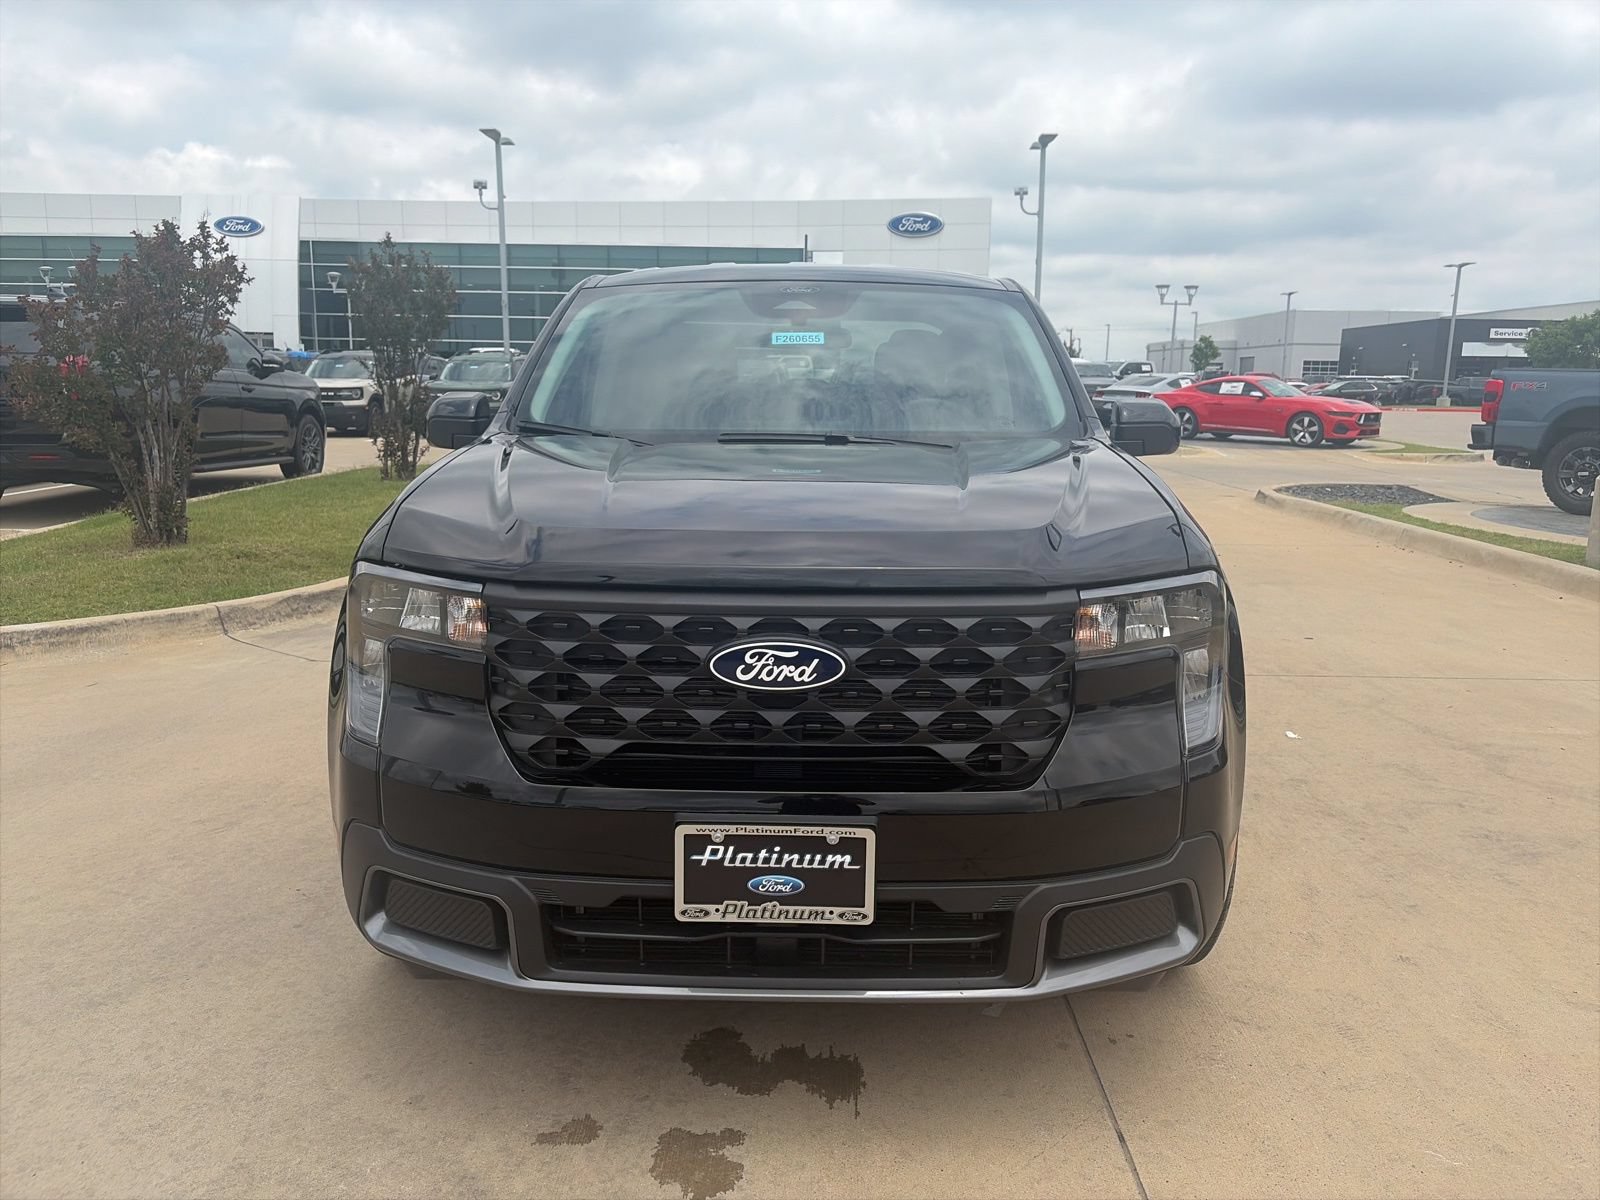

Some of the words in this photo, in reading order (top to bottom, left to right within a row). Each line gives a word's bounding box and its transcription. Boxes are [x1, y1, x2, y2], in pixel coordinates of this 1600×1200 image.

[223, 219, 251, 231] Ford
[898, 216, 931, 231] Ford
[775, 335, 821, 343] F260655
[1511, 381, 1547, 391] FX4
[735, 648, 820, 682] Ford
[695, 826, 856, 836] www.PlatinumFord.com
[690, 845, 862, 869] Platinum
[758, 877, 793, 893] Ford
[685, 909, 706, 918] Ford
[720, 902, 834, 921] Platinum
[842, 912, 863, 921] Ford
